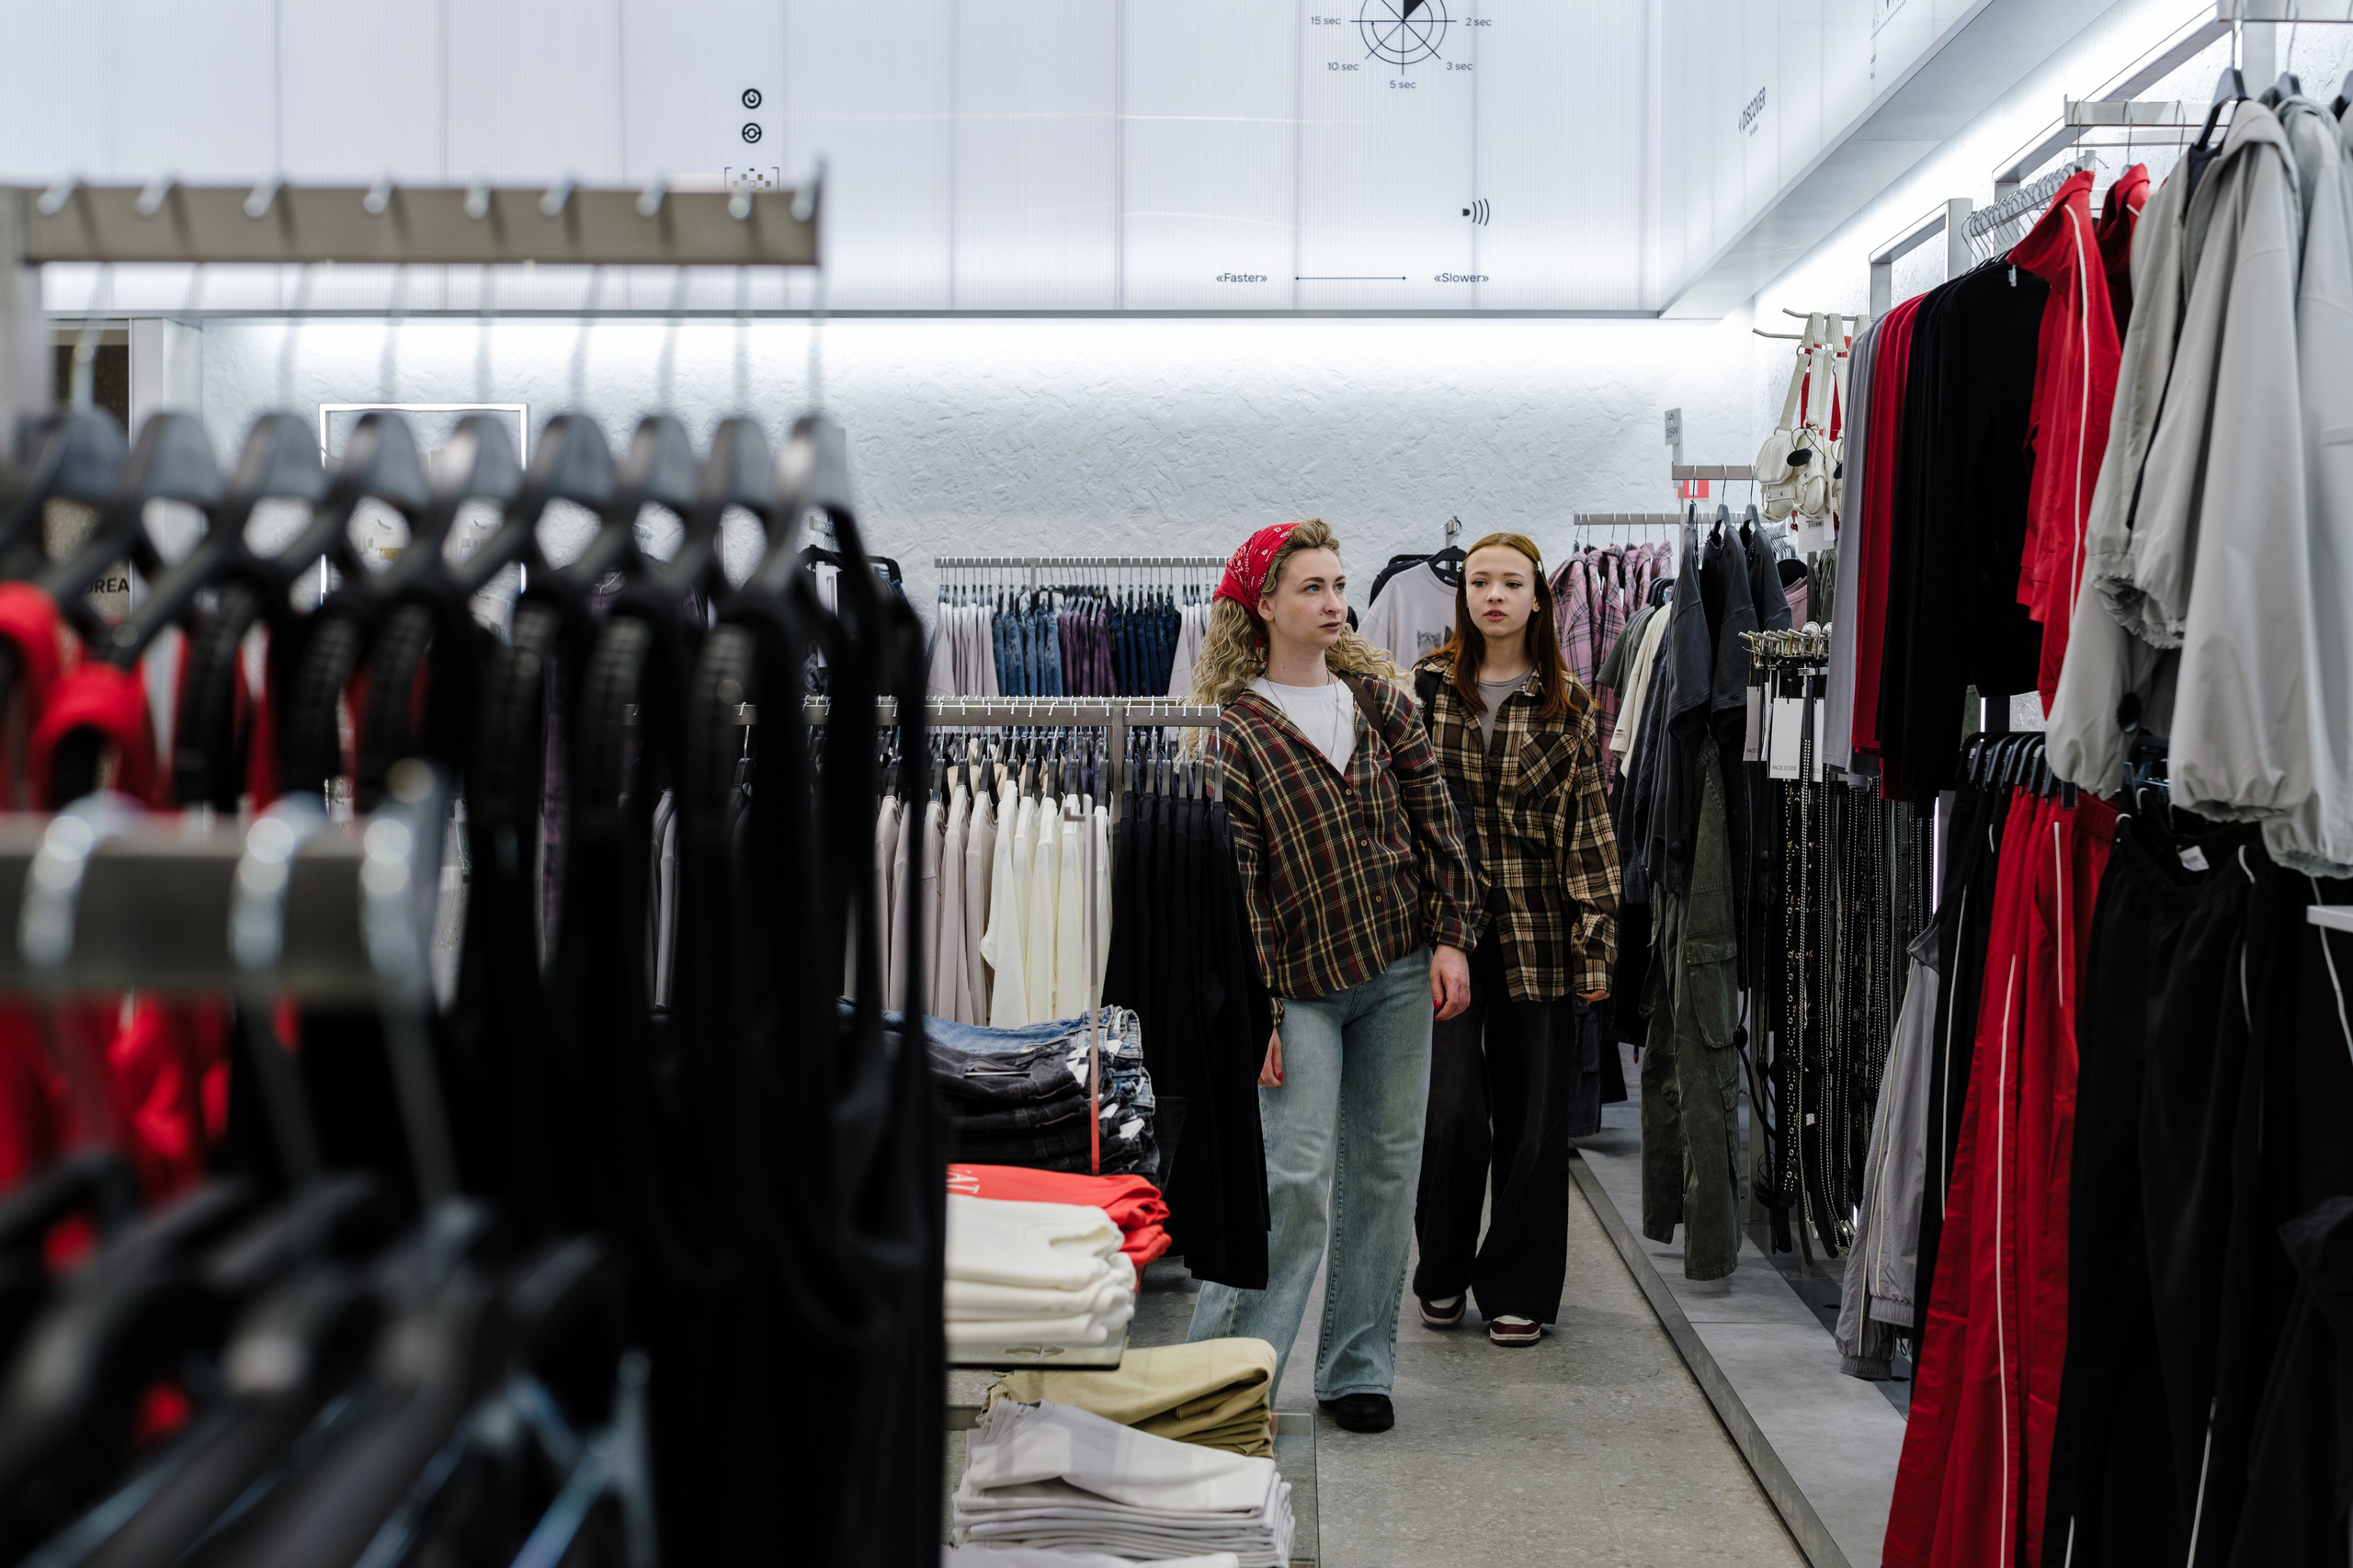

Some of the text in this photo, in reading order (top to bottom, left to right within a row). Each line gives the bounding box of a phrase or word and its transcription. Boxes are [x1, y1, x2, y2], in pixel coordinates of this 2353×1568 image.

[1311, 17, 1321, 26] 15
[1465, 17, 1472, 27] 2
[1327, 62, 1339, 71] 10
[1446, 62, 1453, 71] 3
[1390, 80, 1396, 89] 5
[1742, 86, 1766, 131] DISCOVER
[1215, 272, 1268, 283] «Faster»
[1433, 272, 1490, 283] «Slower»
